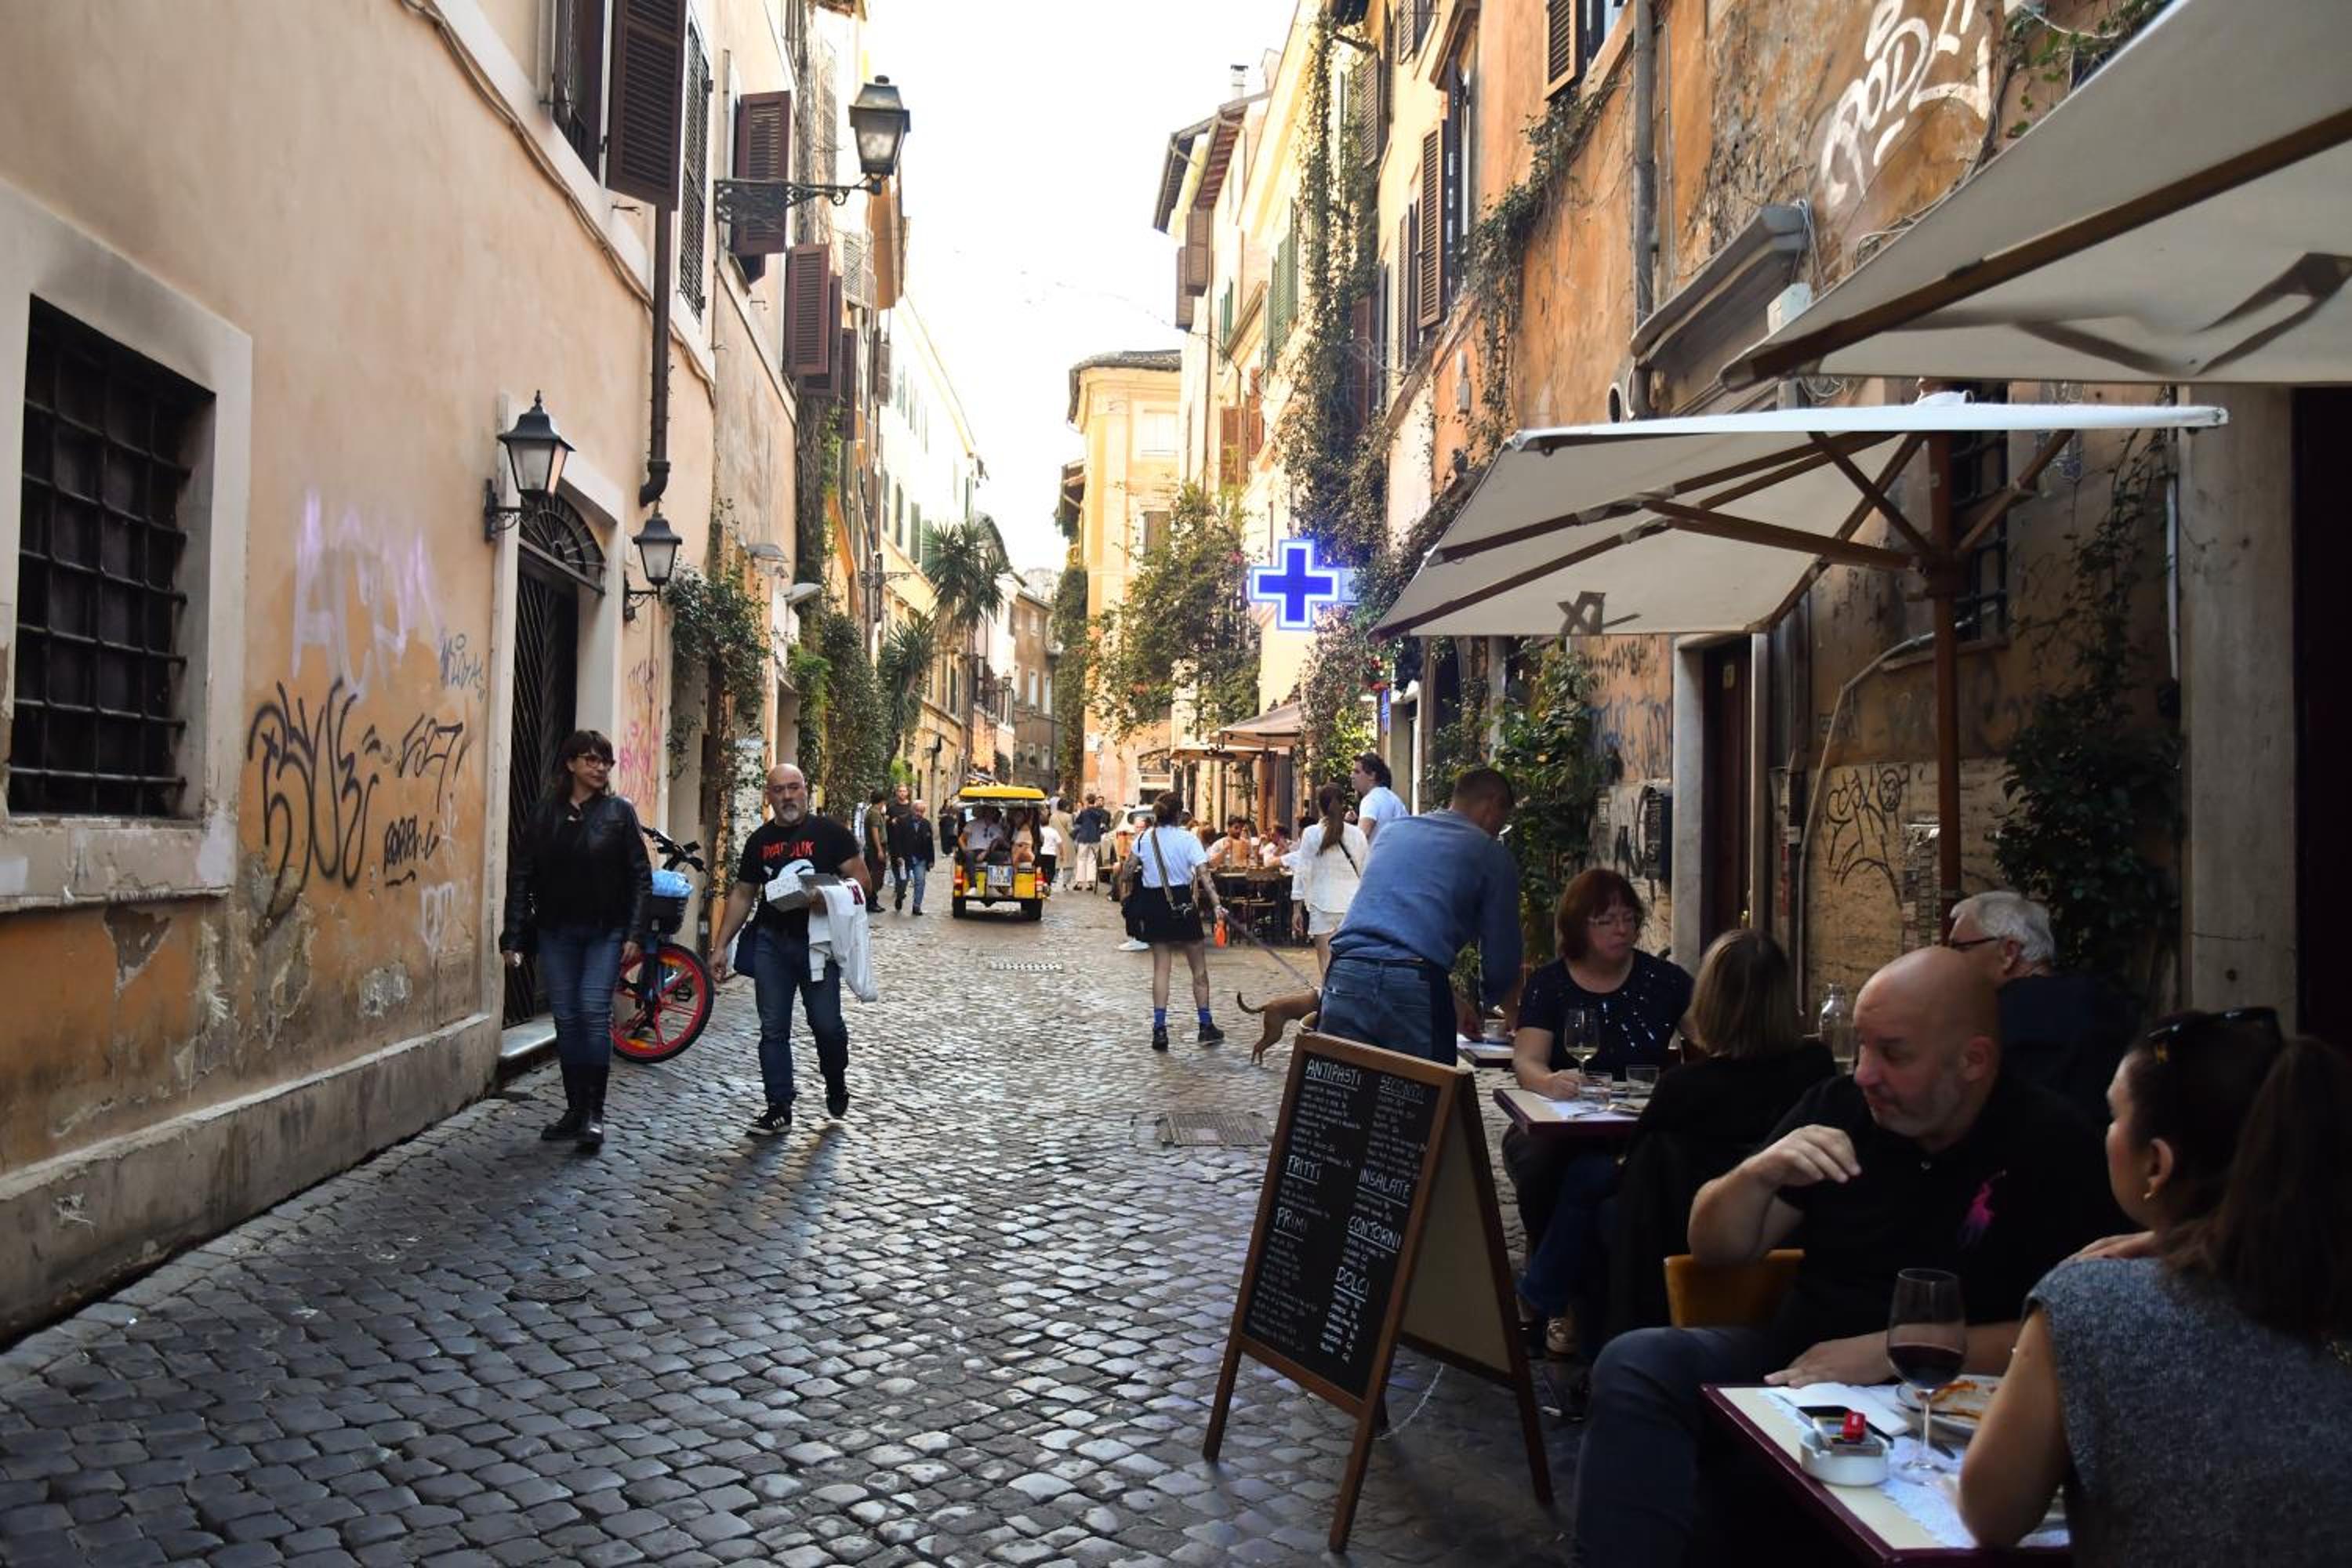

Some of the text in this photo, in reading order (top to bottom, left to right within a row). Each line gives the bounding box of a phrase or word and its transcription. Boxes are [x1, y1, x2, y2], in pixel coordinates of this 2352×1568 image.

[1305, 1059, 1363, 1086] ANTIPASTI
[1287, 1155, 1321, 1180] FRITTI
[1359, 1168, 1410, 1195] INSALATE
[1348, 1216, 1402, 1249] CONTORNI
[1336, 1267, 1370, 1295] DOLCI
